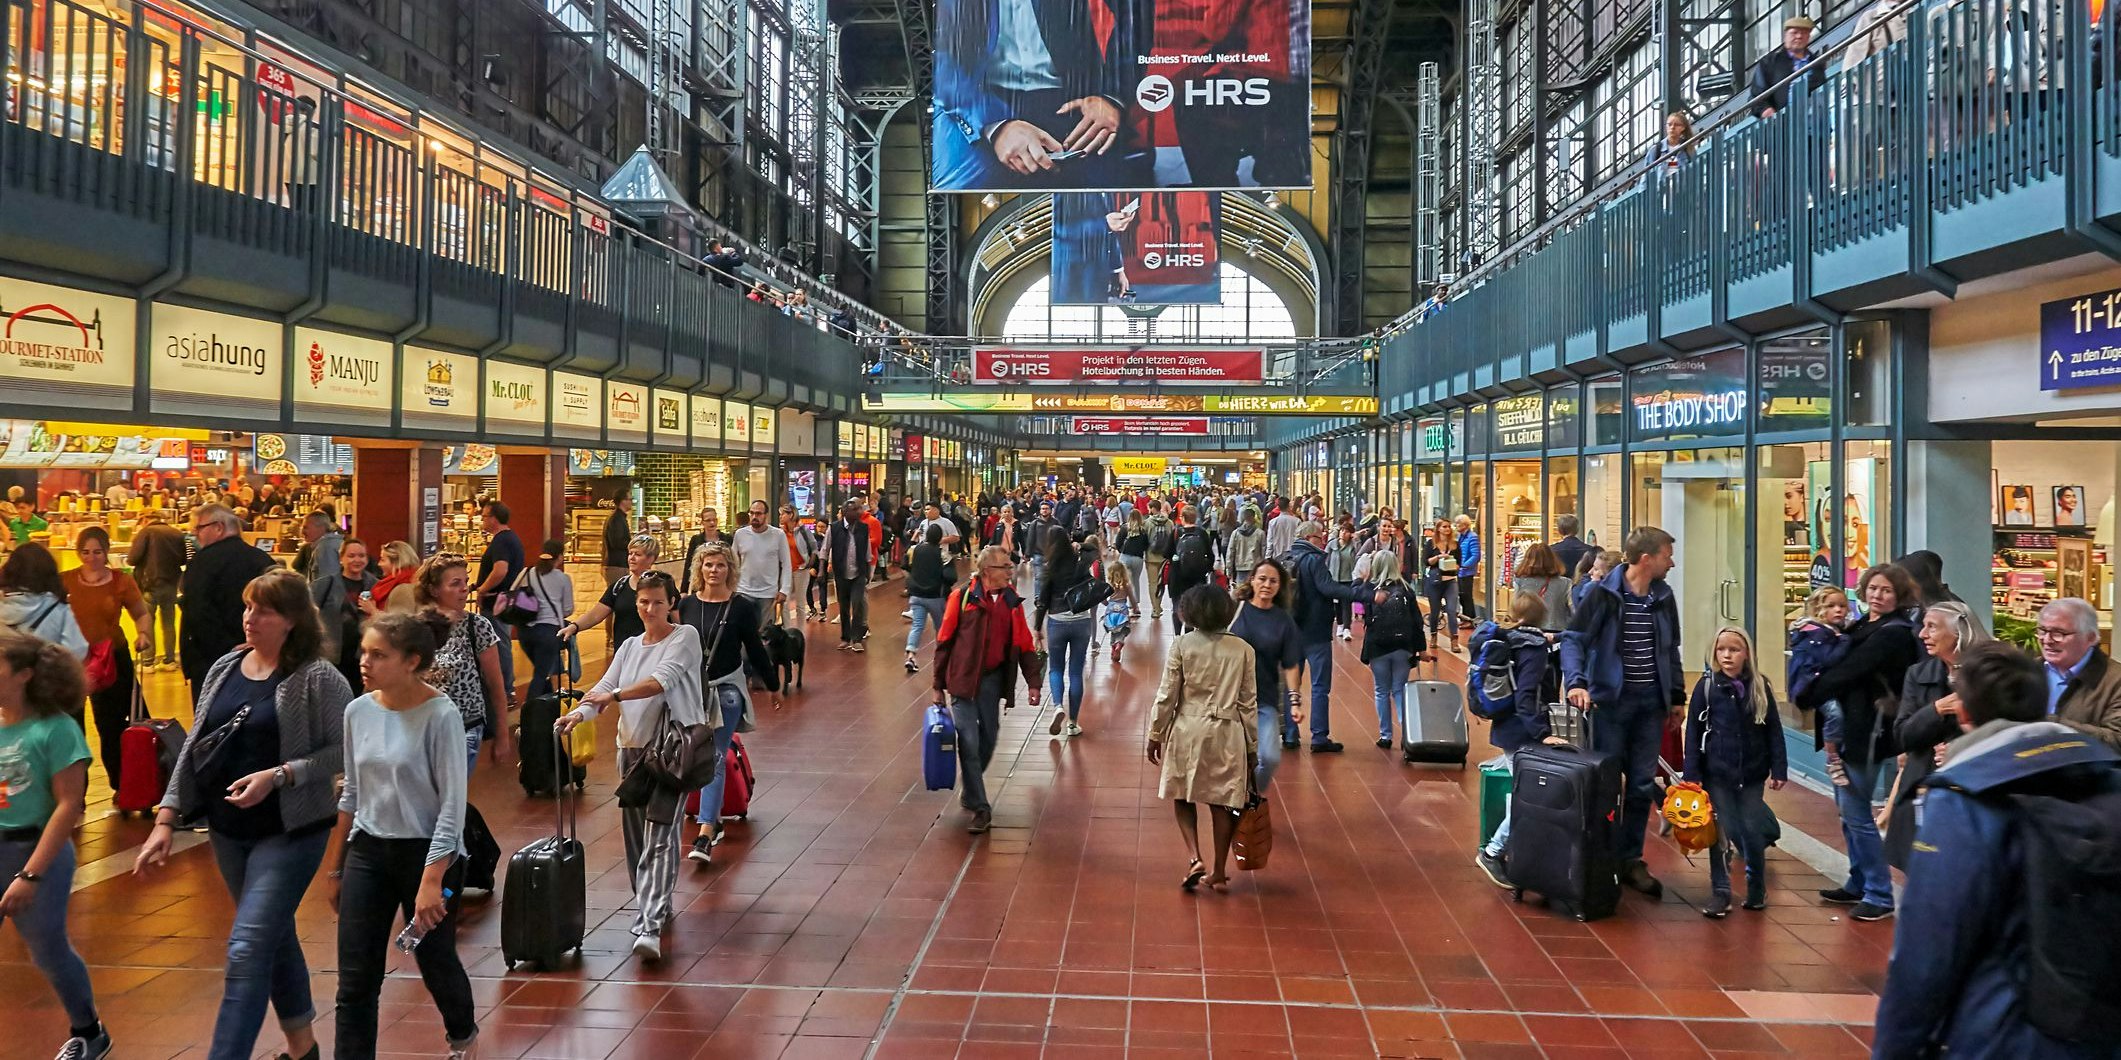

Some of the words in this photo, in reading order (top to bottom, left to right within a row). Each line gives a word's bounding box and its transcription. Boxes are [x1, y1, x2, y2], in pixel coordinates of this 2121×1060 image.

[1138, 54, 1179, 64] Business
[1181, 54, 1214, 63] Travel.
[1216, 54, 1240, 62] Next
[1242, 53, 1270, 62] Level.
[267, 65, 285, 84] 365
[1185, 78, 1271, 106] HRS
[1165, 253, 1205, 267] HRS
[166, 333, 265, 375] asiahung
[1082, 355, 1114, 365] Projekt
[1116, 355, 1125, 364] in
[1127, 355, 1144, 364] den
[1146, 355, 1176, 364] letzten
[1178, 355, 1208, 366] Zügen.
[2070, 353, 2082, 363] zu
[2083, 349, 2100, 362] den
[330, 354, 379, 386] MANJU
[1012, 362, 1050, 375] HRS
[1082, 366, 1144, 376] Hotelbuchung
[1145, 366, 1155, 375] in
[1156, 366, 1186, 375] besten
[1187, 366, 1226, 375] Händen.
[1218, 401, 1229, 409] DU
[1269, 400, 1288, 410] WIR
[1637, 404, 1662, 430] THE
[1665, 397, 1703, 428] BODY
[1705, 390, 1747, 425] SHOP
[1091, 423, 1110, 431] HRS
